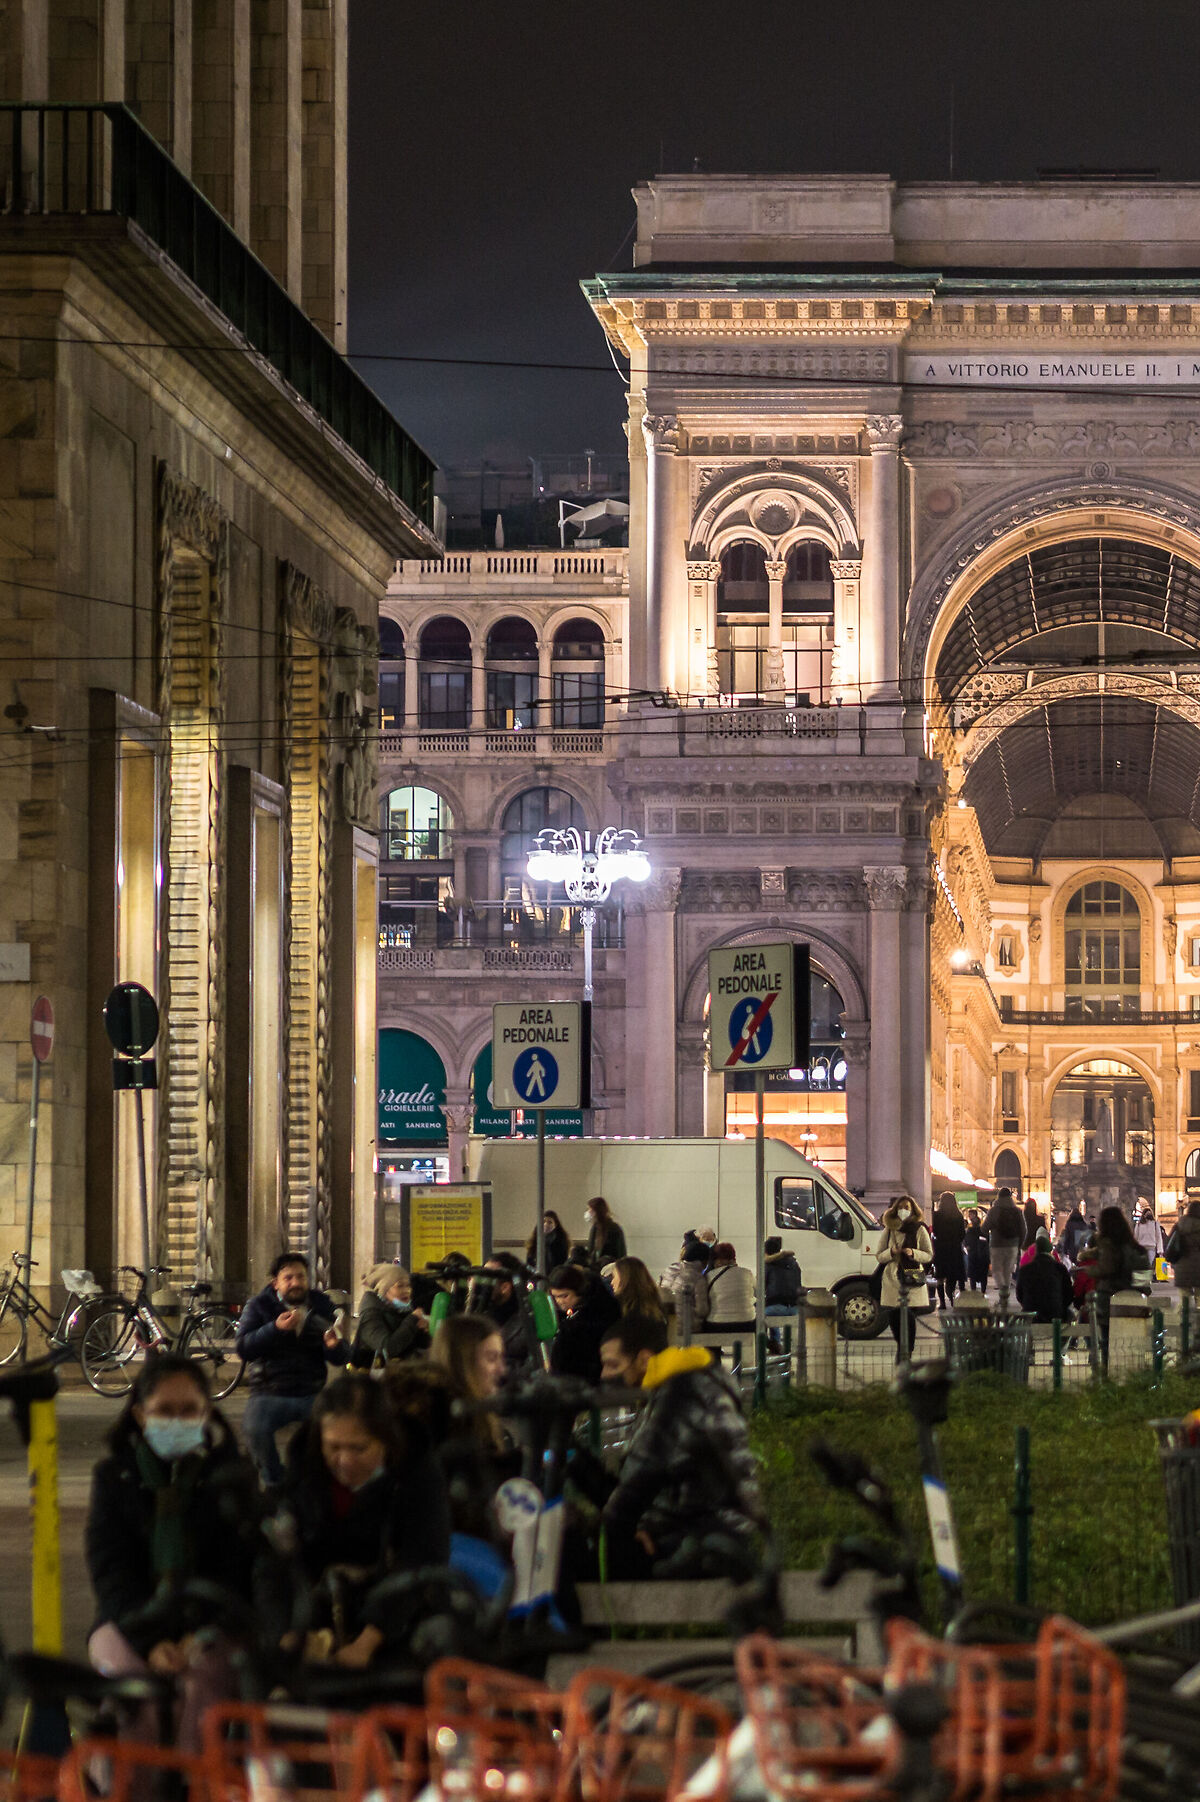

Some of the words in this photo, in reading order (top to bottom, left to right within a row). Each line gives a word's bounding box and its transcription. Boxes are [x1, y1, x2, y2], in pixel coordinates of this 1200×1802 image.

[925, 364, 937, 377] A
[948, 364, 1029, 377] VITTORIO
[1039, 364, 1136, 377] EMANUELE
[1177, 364, 1181, 377] I
[733, 952, 766, 973] AREA
[718, 973, 782, 995] PEDONALE
[520, 1009, 553, 1025] AREA
[503, 1027, 569, 1043] PEDONALE
[384, 1104, 435, 1112] GIOIELLERIE
[380, 1121, 396, 1129] ASTI
[405, 1121, 442, 1129] SANREMO
